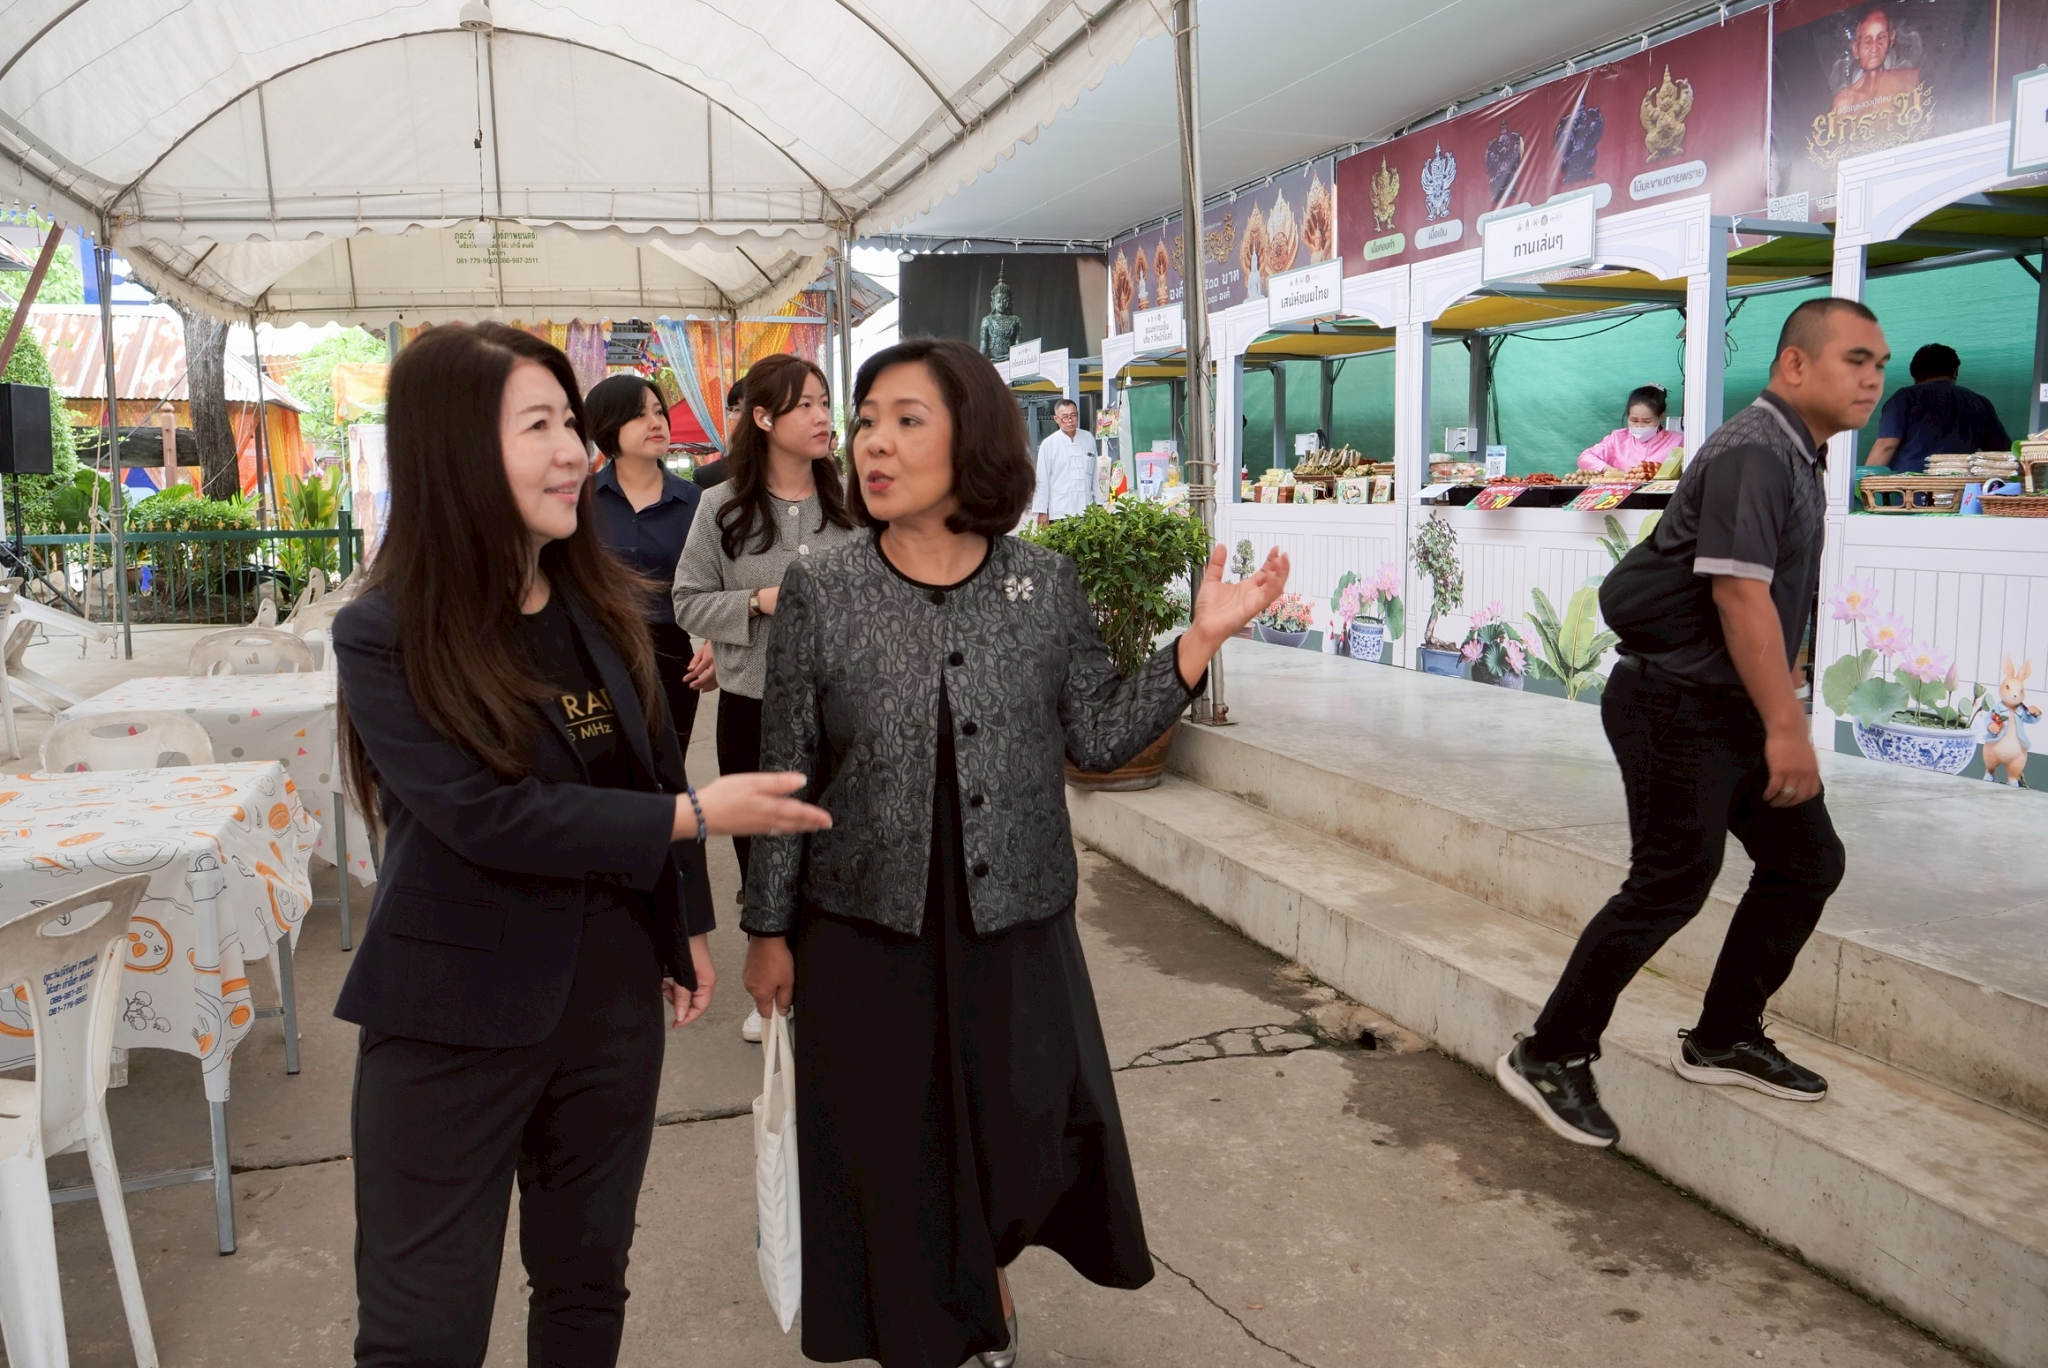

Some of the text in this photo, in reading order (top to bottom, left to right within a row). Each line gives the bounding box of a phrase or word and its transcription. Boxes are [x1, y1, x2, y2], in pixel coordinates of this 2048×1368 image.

[1513, 232, 1564, 258] ทานเล่นๆ
[1281, 286, 1329, 309] เสน่ห์ขนมไทย
[1490, 495, 1514, 509] 10
[1594, 495, 1624, 510] 25
[581, 721, 613, 740] MHz
